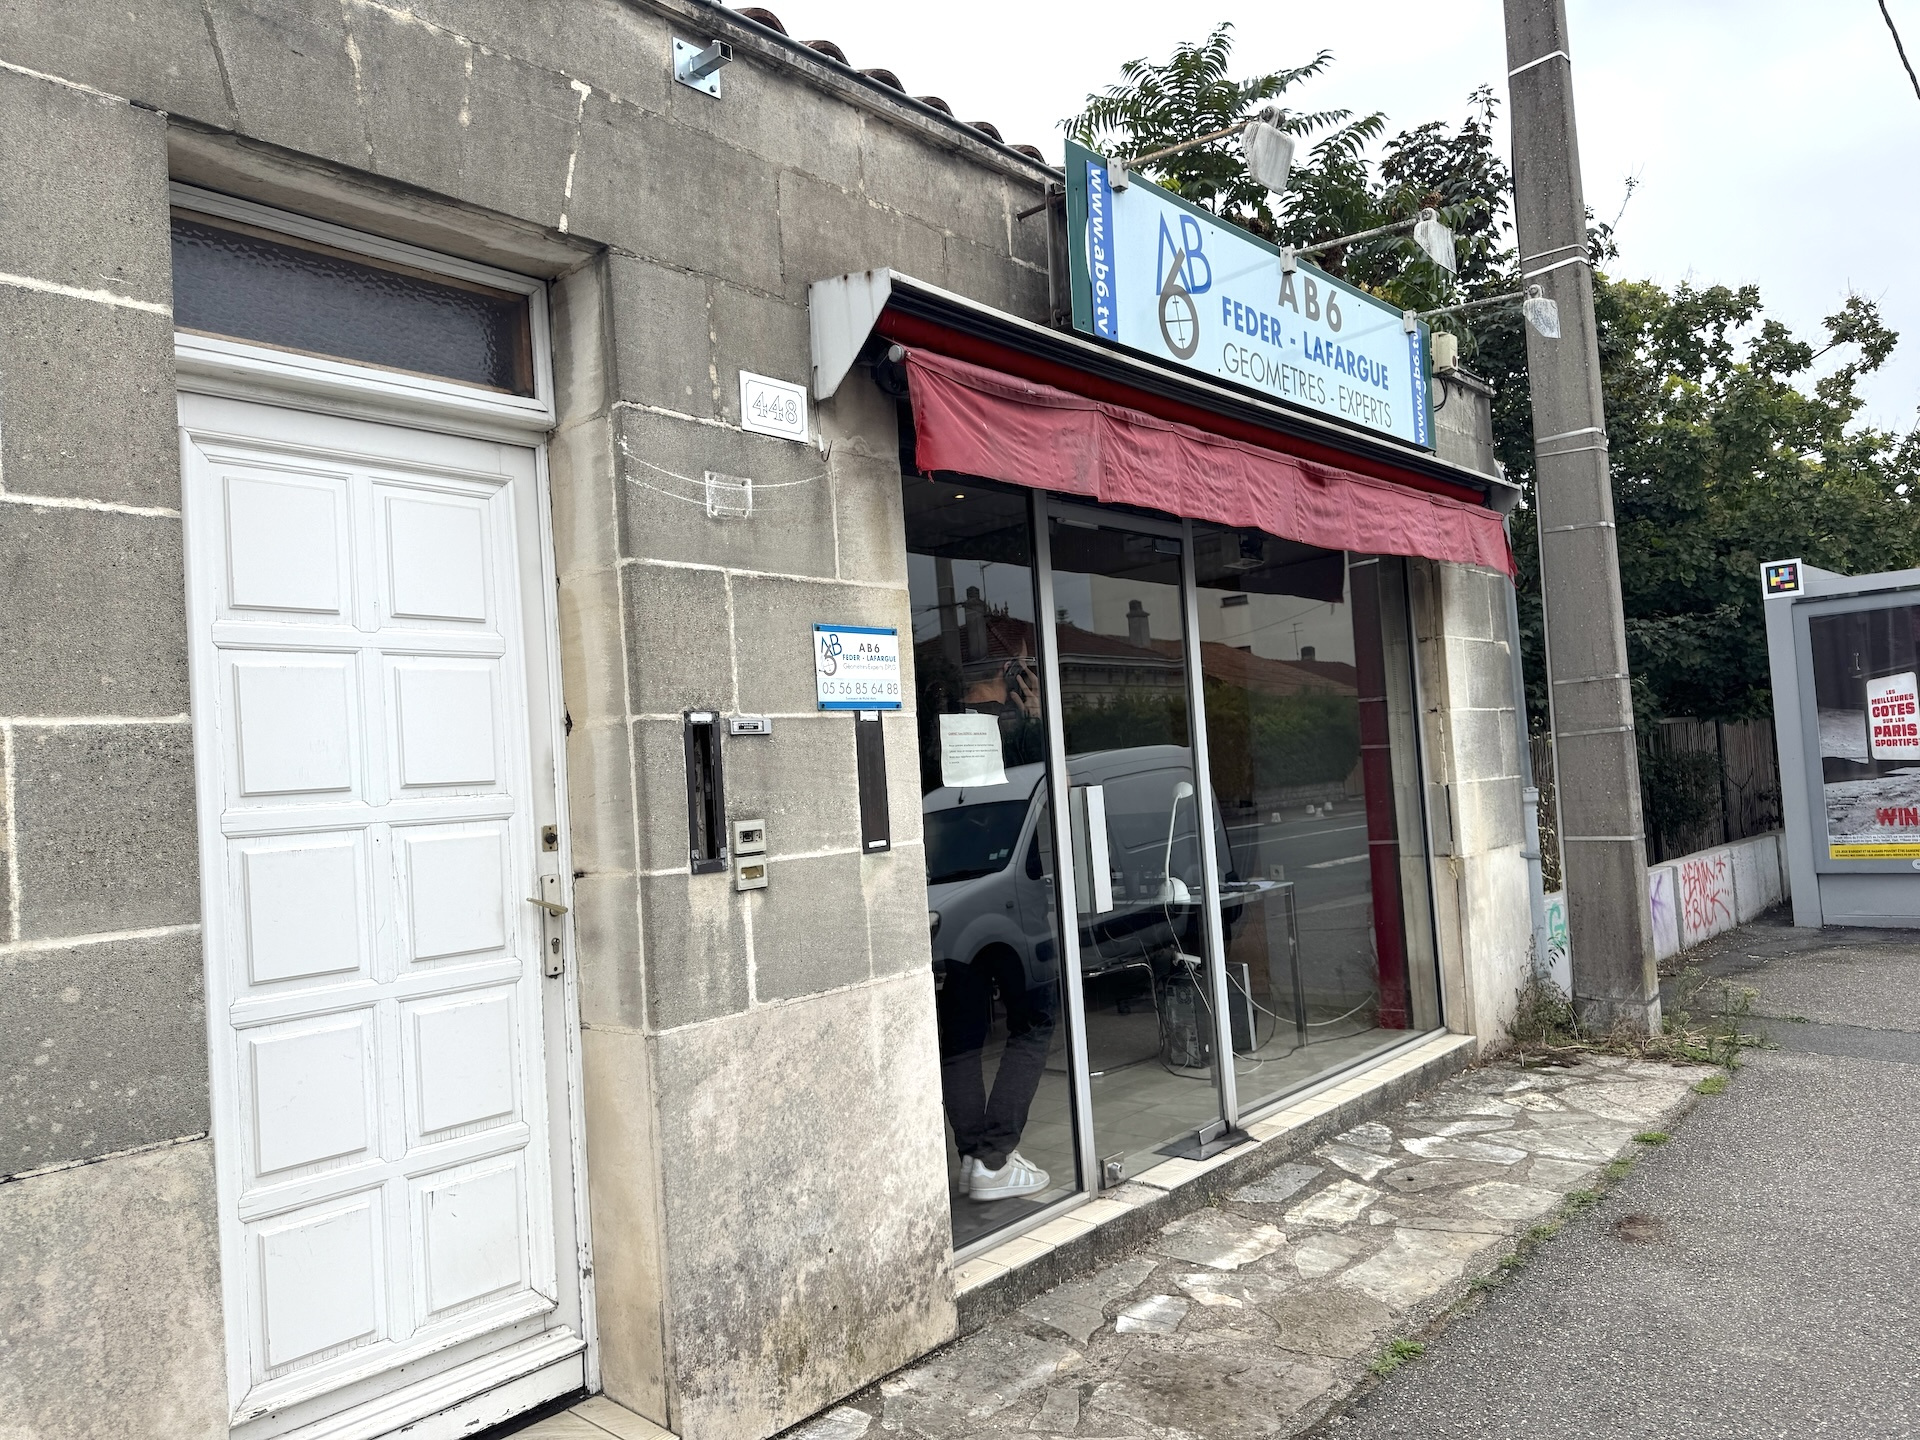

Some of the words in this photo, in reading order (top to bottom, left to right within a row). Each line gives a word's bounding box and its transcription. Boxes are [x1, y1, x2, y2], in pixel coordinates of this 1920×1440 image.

[1090, 169, 1109, 335] www.ab6.tv
[1222, 295, 1284, 349] FEDER
[1303, 330, 1389, 391] LAFARGUE
[1223, 342, 1326, 405] GEOMETRES
[1338, 384, 1392, 429] EXPERTS
[752, 391, 798, 425] 448
[866, 655, 896, 663] LAFARGUE
[822, 682, 835, 694] 05
[839, 682, 852, 695] 56
[855, 682, 868, 695] 85
[871, 682, 884, 695] 64
[886, 683, 899, 695] 88
[1871, 693, 1914, 705] MEILLEURES
[1872, 702, 1915, 718] COTES
[1873, 723, 1917, 737] PARIS
[1876, 807, 1920, 826] WIN
